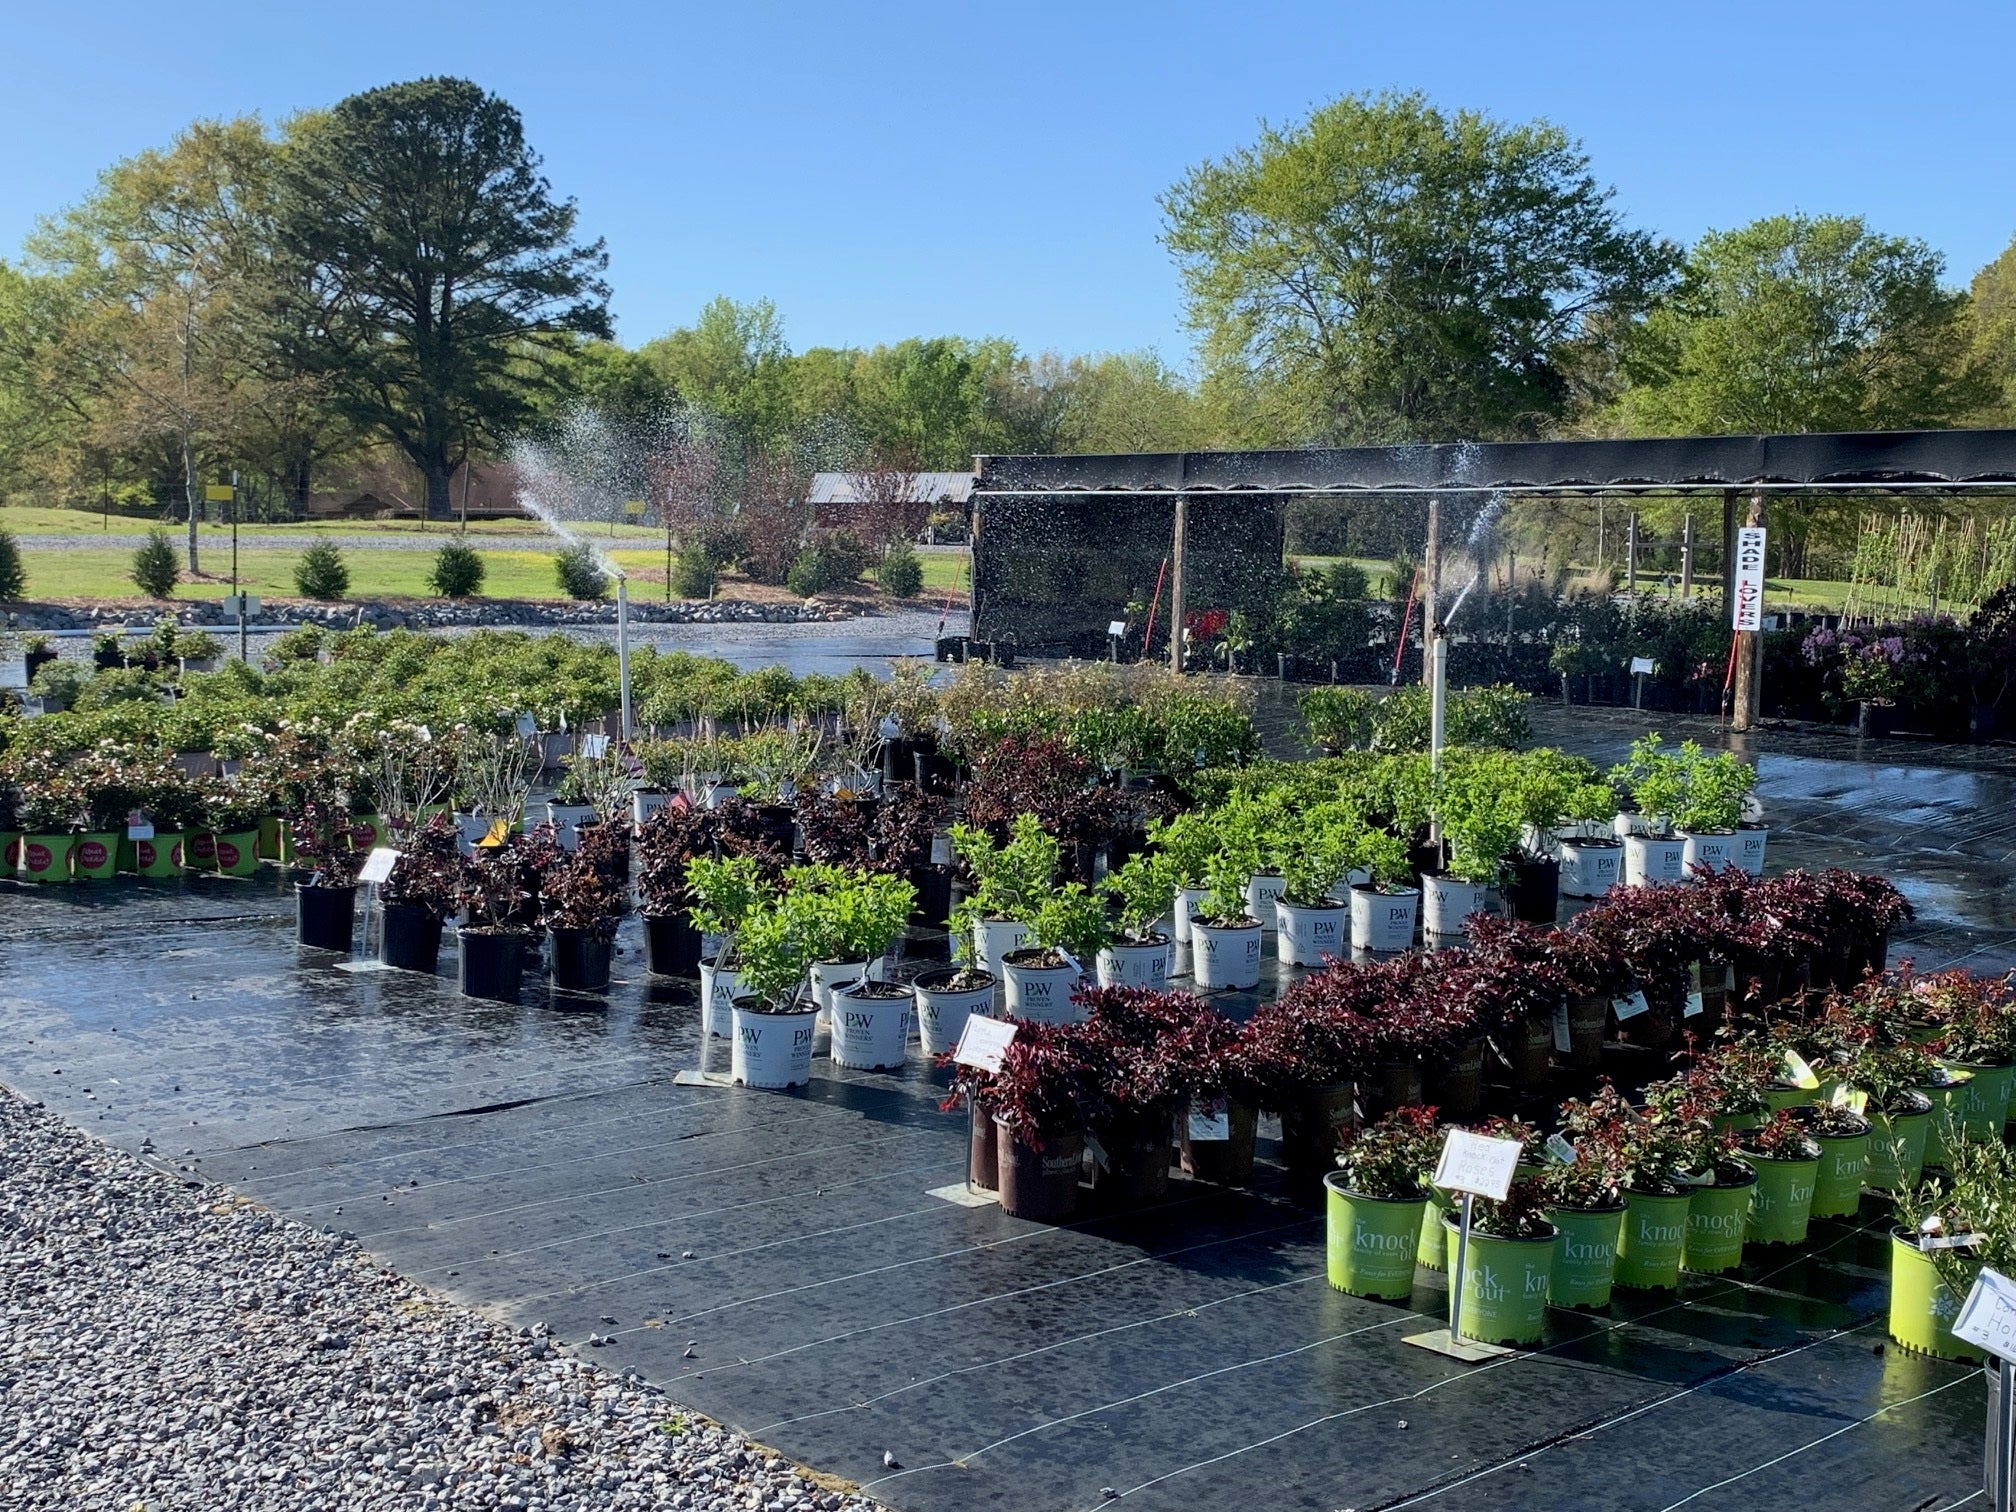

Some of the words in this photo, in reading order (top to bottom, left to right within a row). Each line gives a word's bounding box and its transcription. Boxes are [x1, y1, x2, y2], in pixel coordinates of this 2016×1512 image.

[1742, 532, 1760, 570] SHADE
[1739, 580, 1758, 625] LOVERS
[1703, 845, 1723, 855] PW
[1744, 840, 1762, 850] PW
[1598, 859, 1616, 870] PW
[1259, 888, 1281, 899] PW
[1390, 908, 1410, 920] PW
[1314, 922, 1336, 934] PW
[1104, 958, 1125, 972] PW
[712, 986, 736, 999] PW
[1025, 983, 1053, 996] PW
[921, 1004, 940, 1020] PW
[846, 1013, 874, 1029] PW
[739, 1026, 762, 1044] PW
[793, 1029, 812, 1046] PW
[1459, 1160, 1495, 1177] Roses
[1790, 1183, 1814, 1201] kno
[1356, 1224, 1415, 1250] knock
[1400, 1249, 1415, 1261] ou
[1475, 1285, 1510, 1302] out
